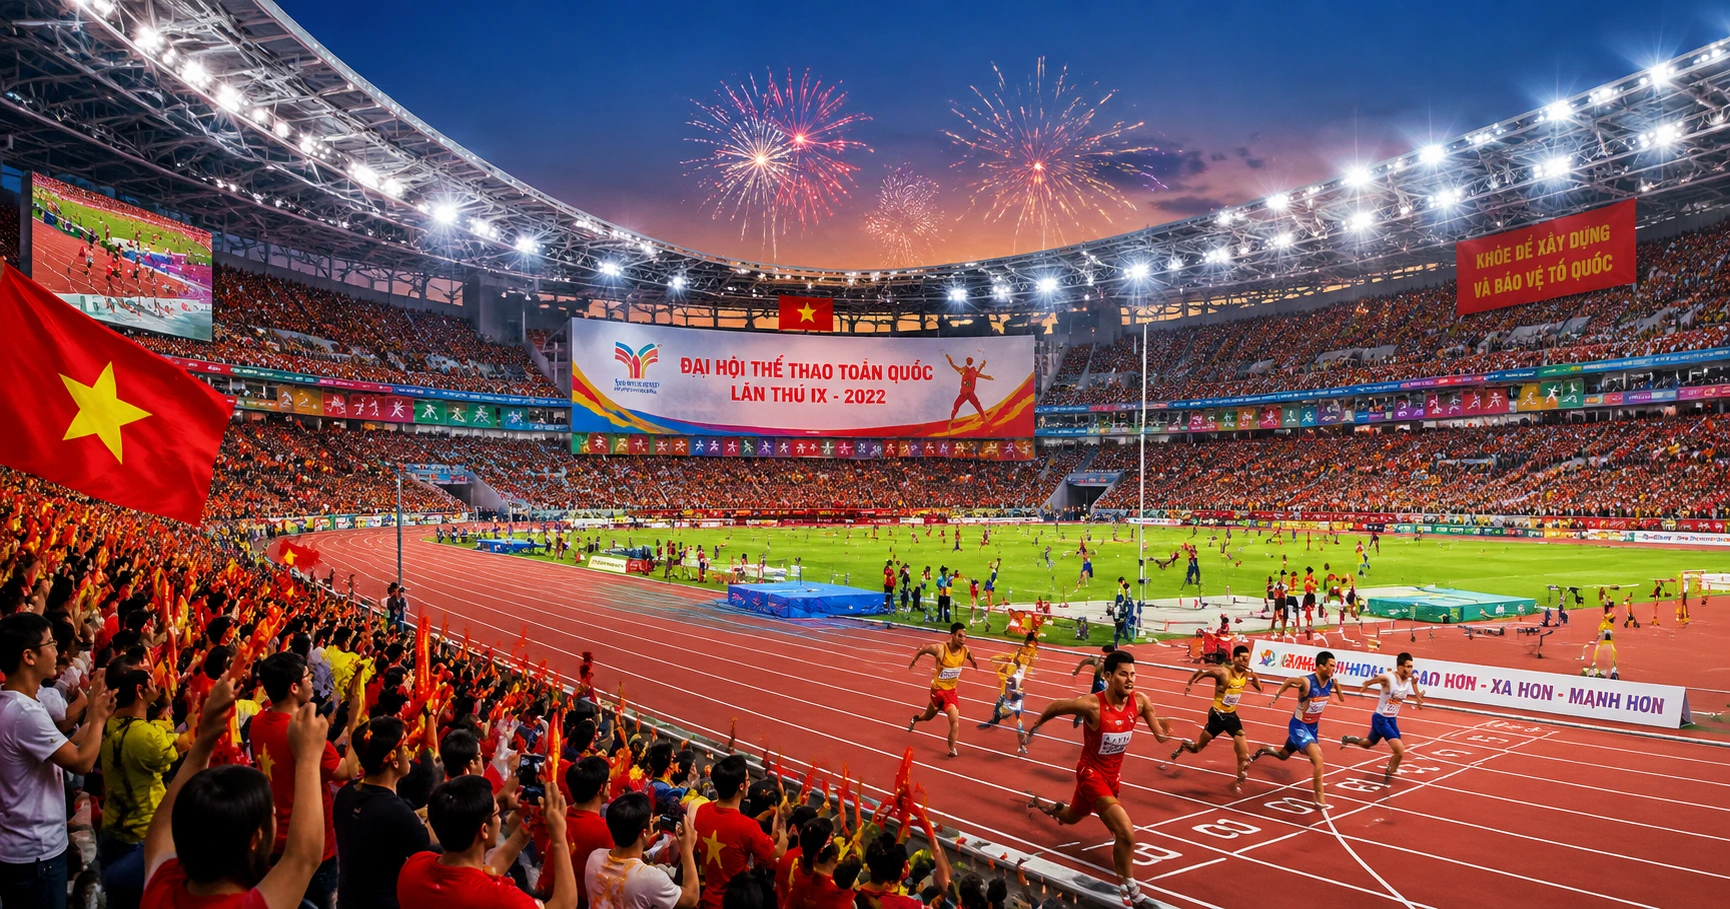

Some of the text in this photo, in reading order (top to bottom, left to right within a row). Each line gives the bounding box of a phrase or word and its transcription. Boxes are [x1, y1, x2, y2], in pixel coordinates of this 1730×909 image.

[716, 355, 745, 379] HỘI
[788, 362, 833, 380] THAO
[887, 359, 933, 384] QUỐC
[811, 388, 827, 404] IX
[844, 389, 886, 404] 2022
[1490, 678, 1512, 696] XA
